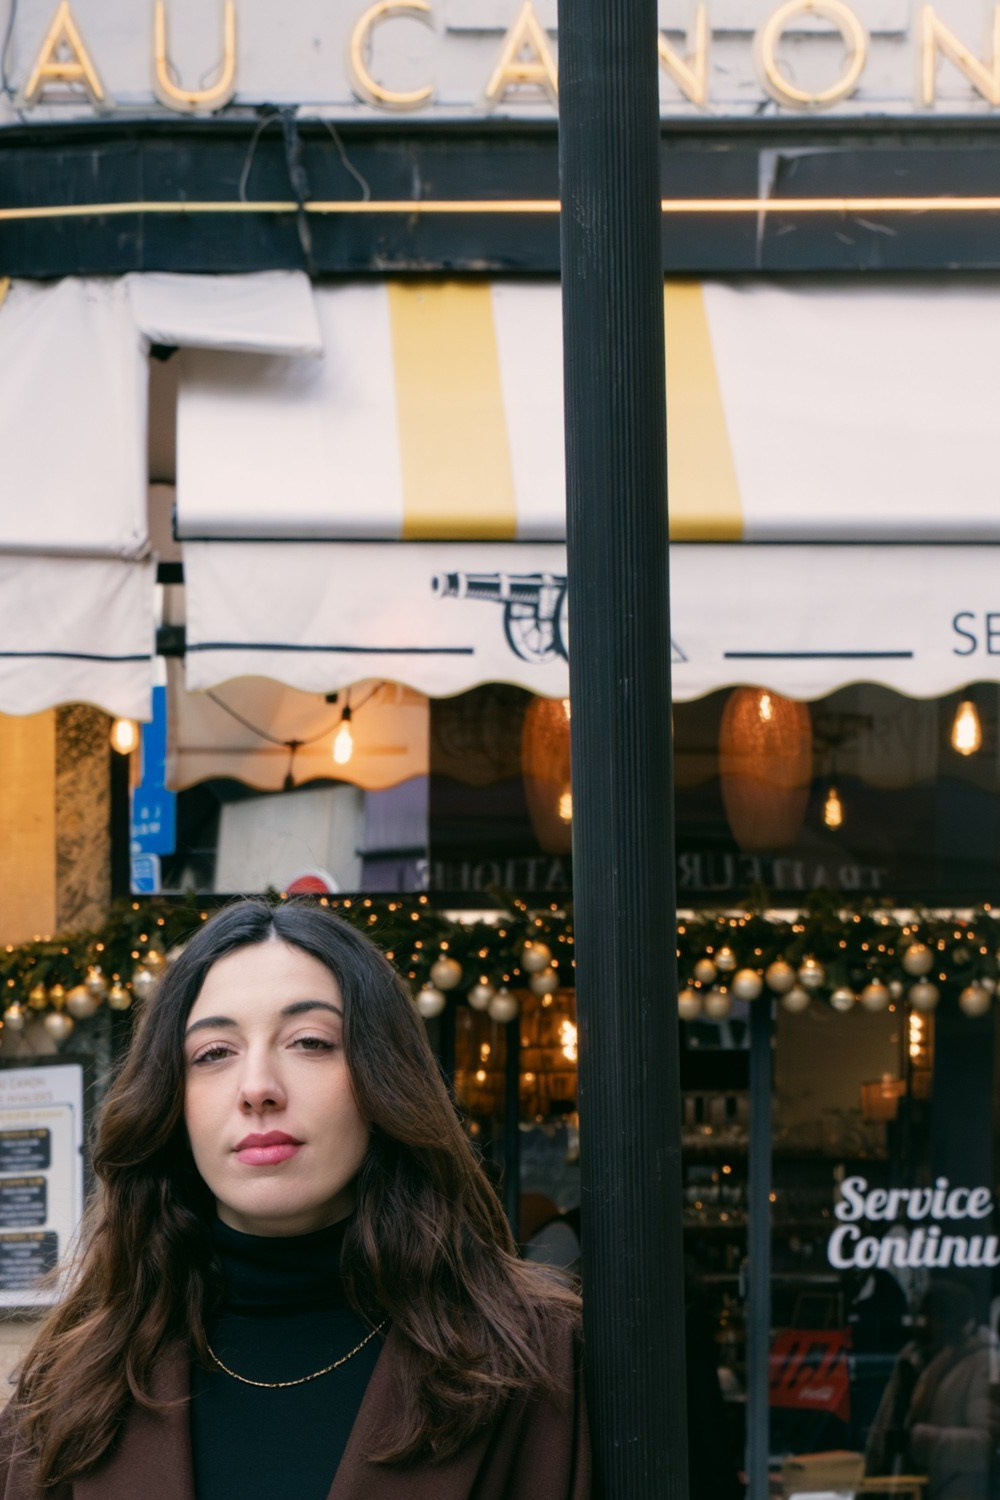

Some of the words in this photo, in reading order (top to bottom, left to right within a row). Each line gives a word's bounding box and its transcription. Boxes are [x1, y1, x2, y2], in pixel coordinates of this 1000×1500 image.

[20, 0, 238, 108] AU
[834, 1175, 994, 1222] Service
[827, 1223, 1000, 1269] Continu
